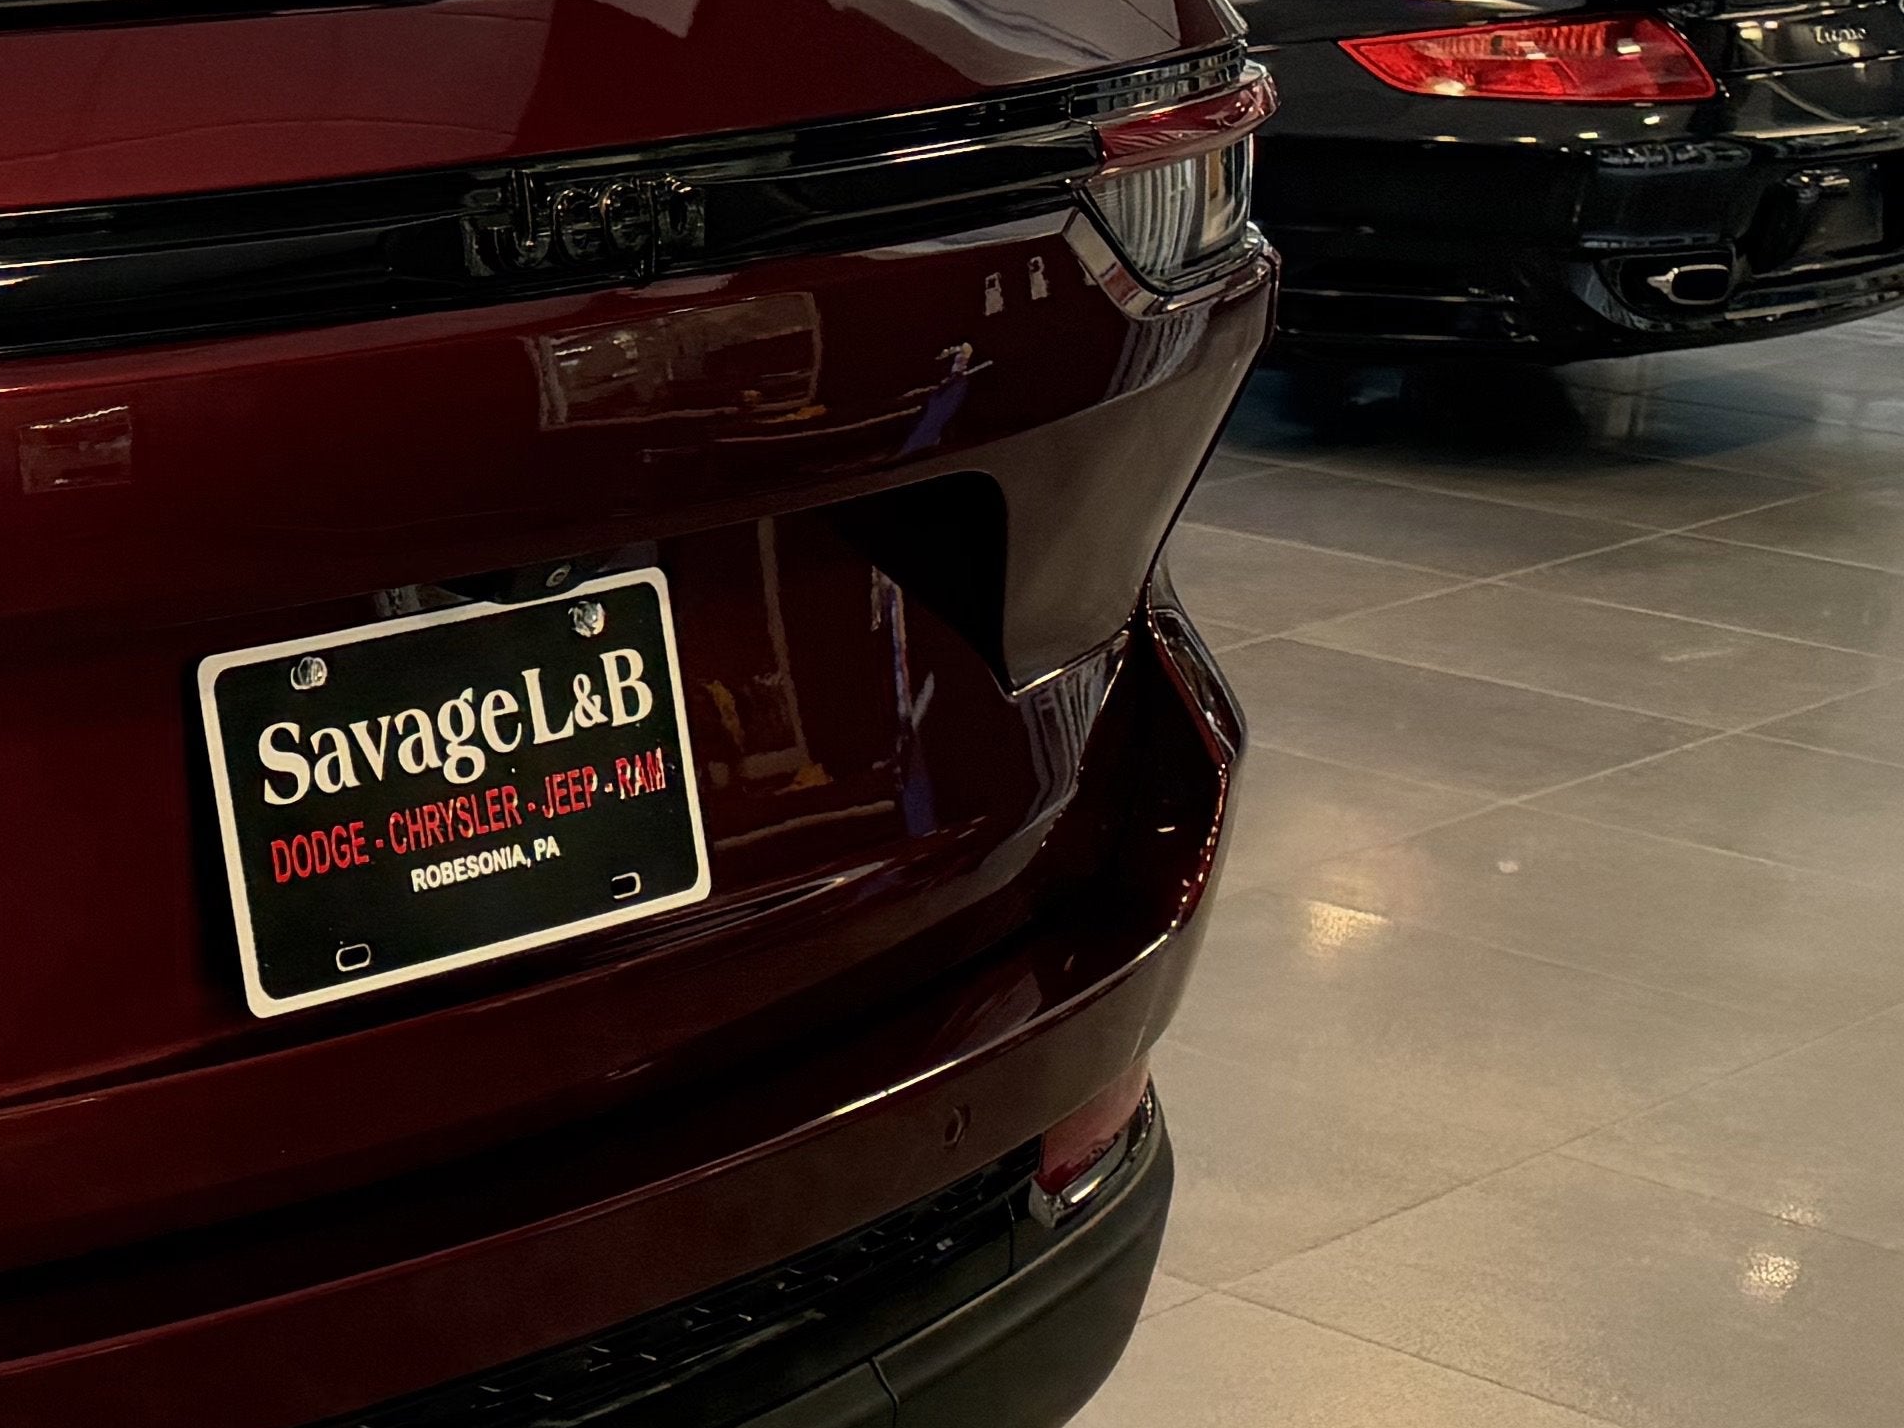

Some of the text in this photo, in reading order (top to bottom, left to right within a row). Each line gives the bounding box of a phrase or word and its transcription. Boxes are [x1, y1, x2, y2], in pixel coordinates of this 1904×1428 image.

[271, 821, 370, 884] DODGE
[389, 784, 524, 856] CHRYSLER
[542, 765, 597, 818] JEEP
[614, 747, 666, 799] RAM
[410, 835, 560, 893] ROBESONIA, PA
